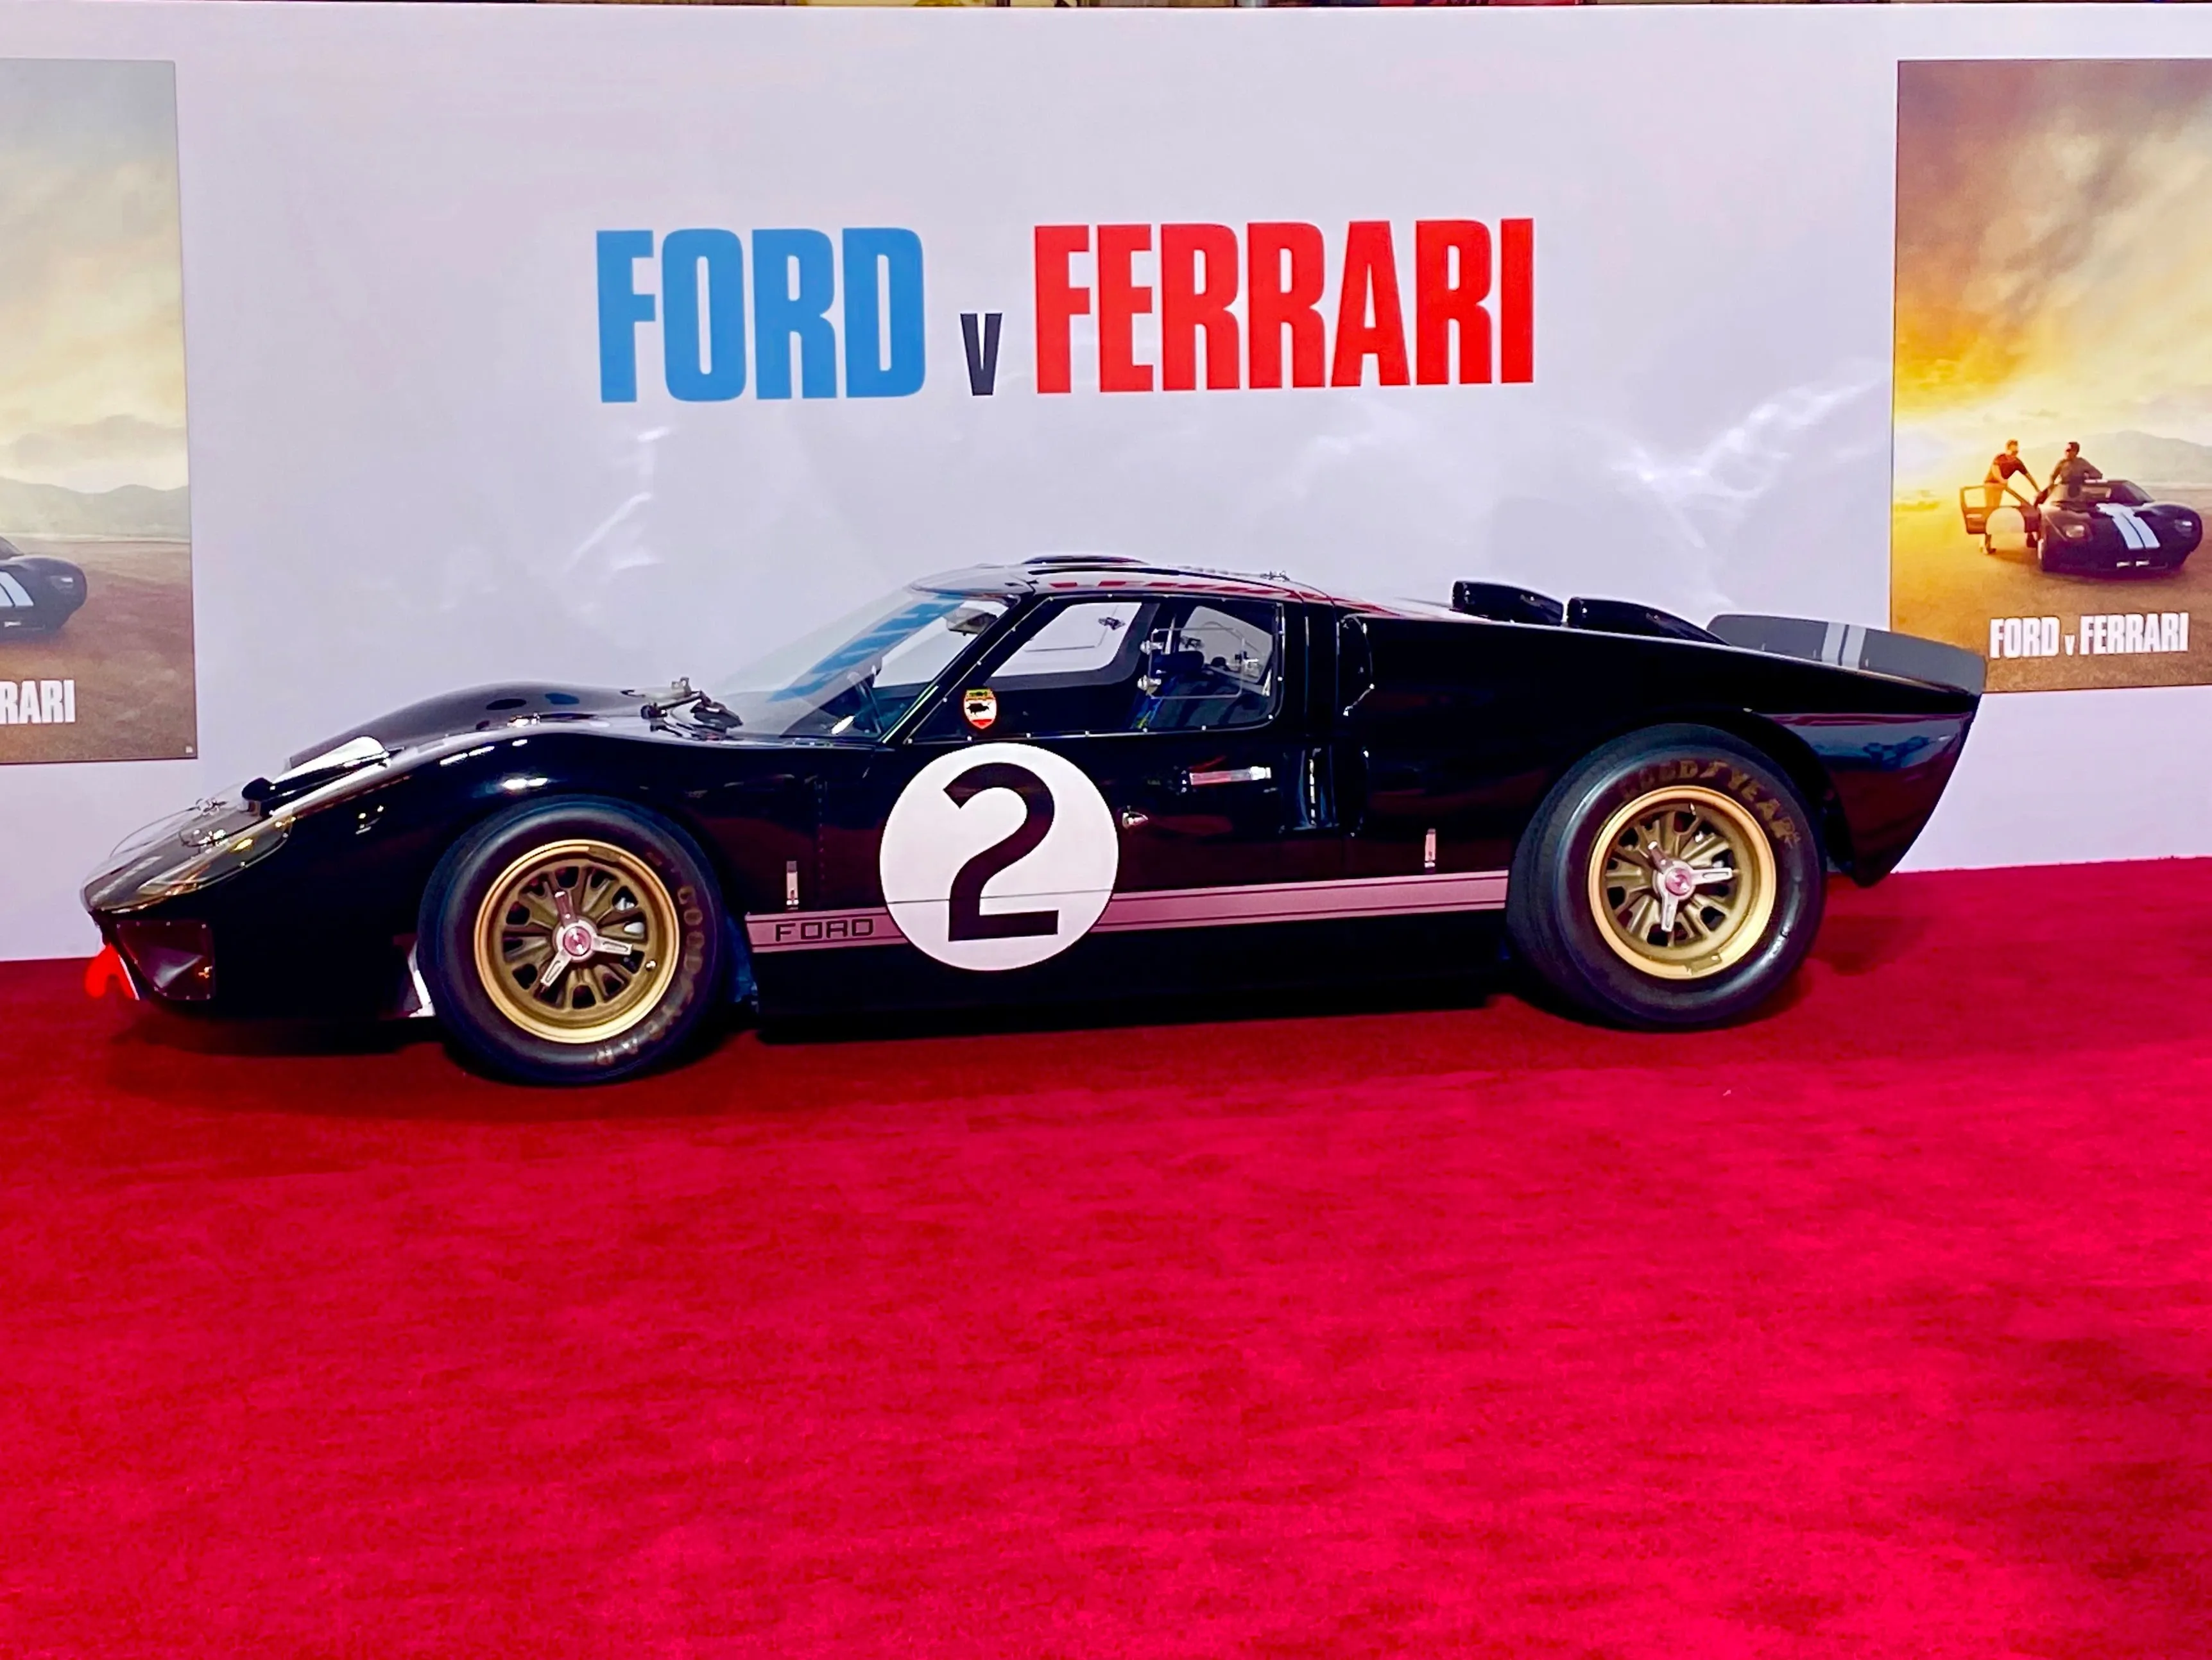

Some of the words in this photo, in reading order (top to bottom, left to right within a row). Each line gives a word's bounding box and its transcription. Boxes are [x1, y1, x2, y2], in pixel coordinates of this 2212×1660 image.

[596, 228, 925, 402] FORD
[1034, 218, 1534, 393] FERRARI
[1990, 615, 2060, 658] FORD
[2080, 612, 2190, 655] FERRARI
[943, 762, 1059, 942] 2
[775, 918, 873, 942] FORD
